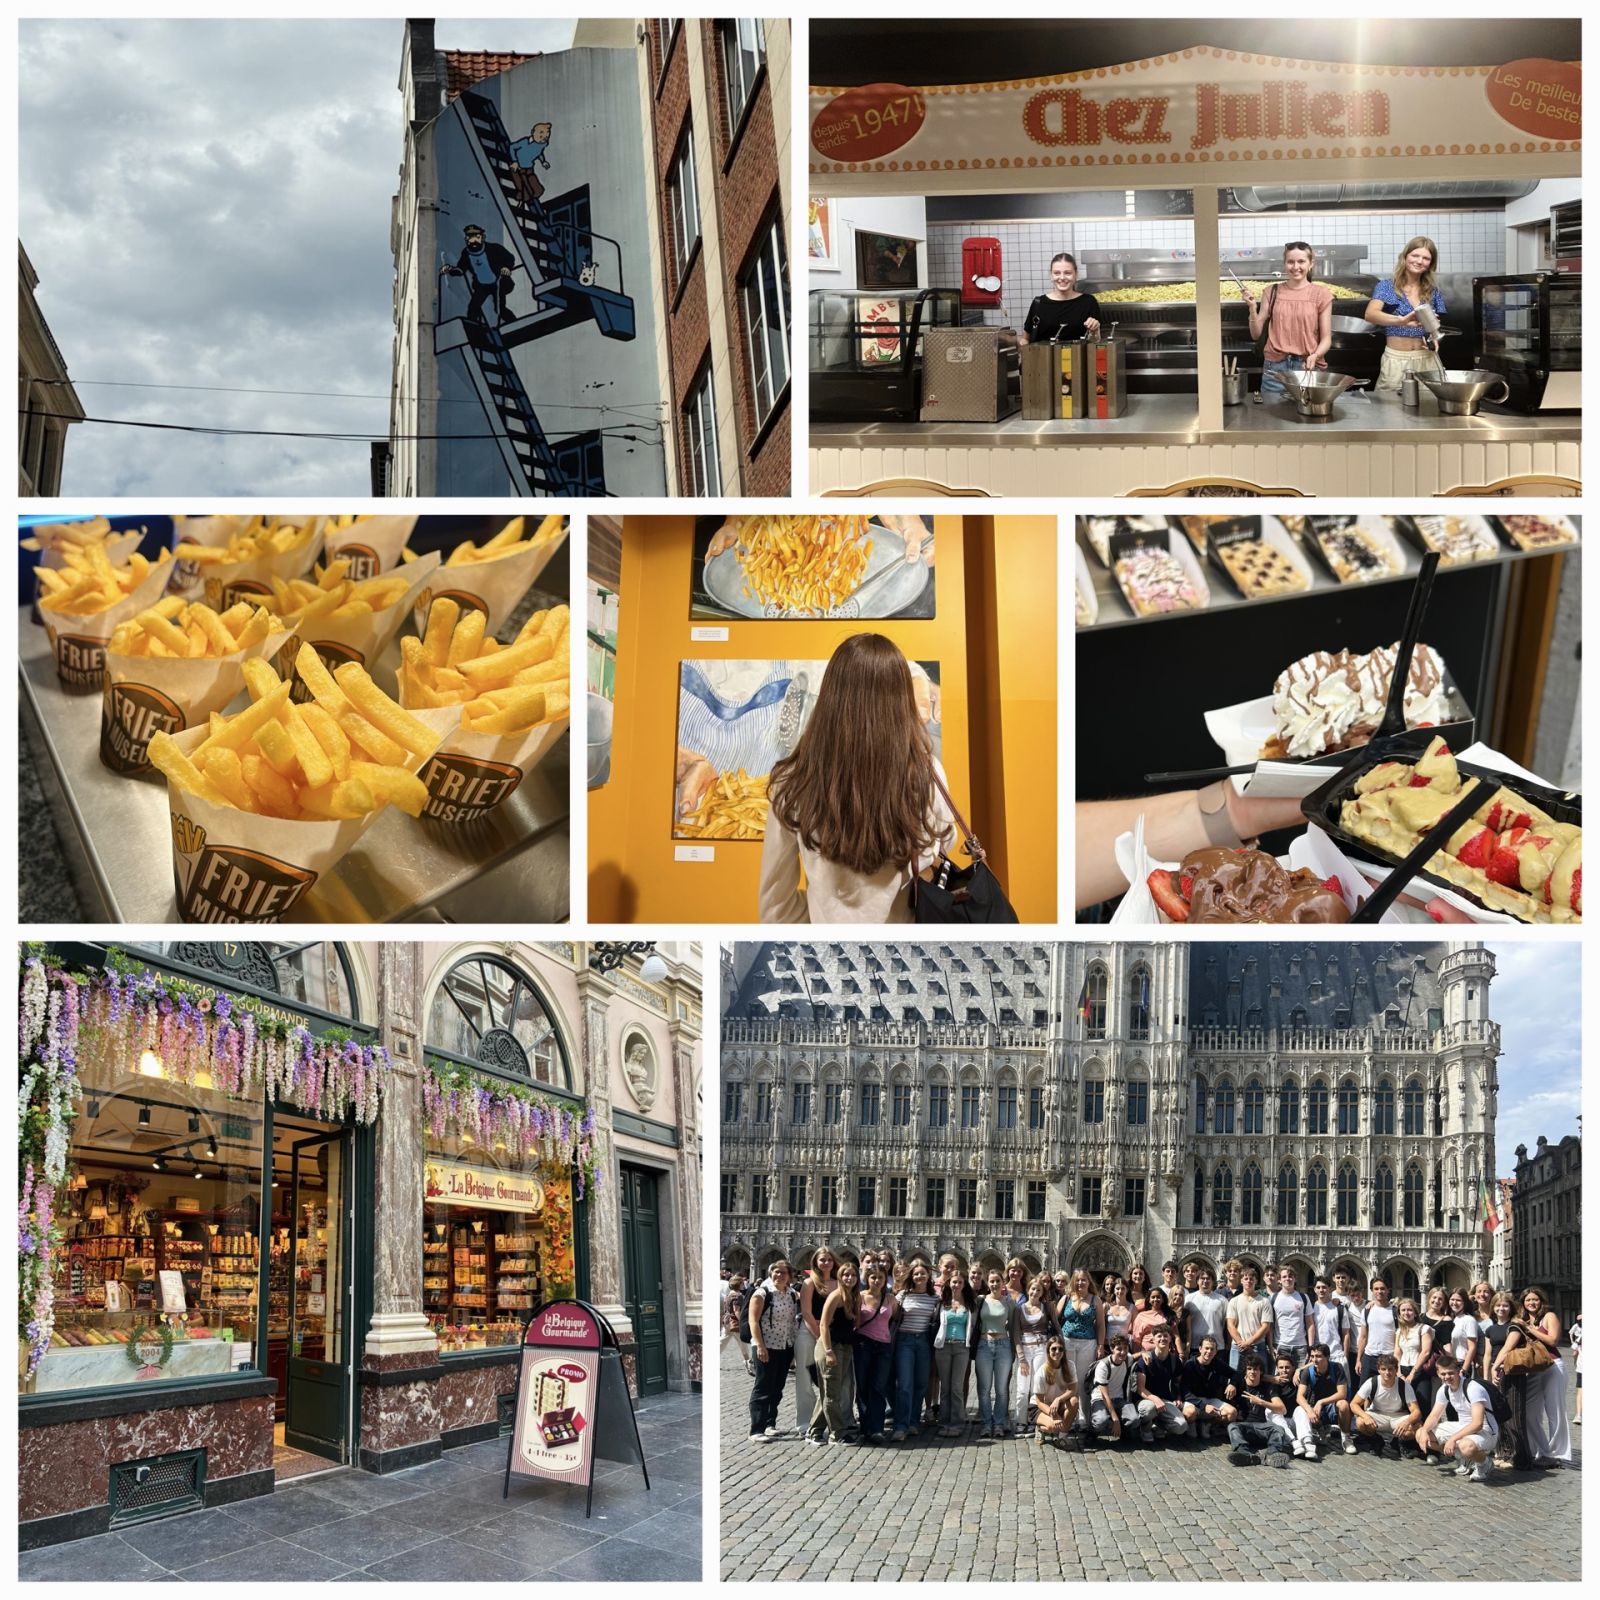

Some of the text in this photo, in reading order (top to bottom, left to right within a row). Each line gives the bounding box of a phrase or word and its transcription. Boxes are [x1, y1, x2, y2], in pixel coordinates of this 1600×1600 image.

[1494, 68, 1522, 88] Les
[1509, 91, 1532, 111] De
[850, 93, 924, 139] 1947!
[1023, 80, 1390, 150] Chez Julien
[813, 119, 851, 139] depuis
[818, 133, 848, 152] sinds
[60, 638, 104, 670] FRIE
[114, 688, 179, 742] FRIET
[109, 720, 150, 766] MUSEU
[424, 758, 516, 805] FRIET
[201, 852, 310, 915] FRIET
[223, 942, 238, 958] 17
[451, 1172, 534, 1203] La Belgique Gourmande
[552, 1312, 587, 1331] Belgique
[140, 1347, 161, 1358] 2004
[560, 1367, 585, 1379] PROMO
